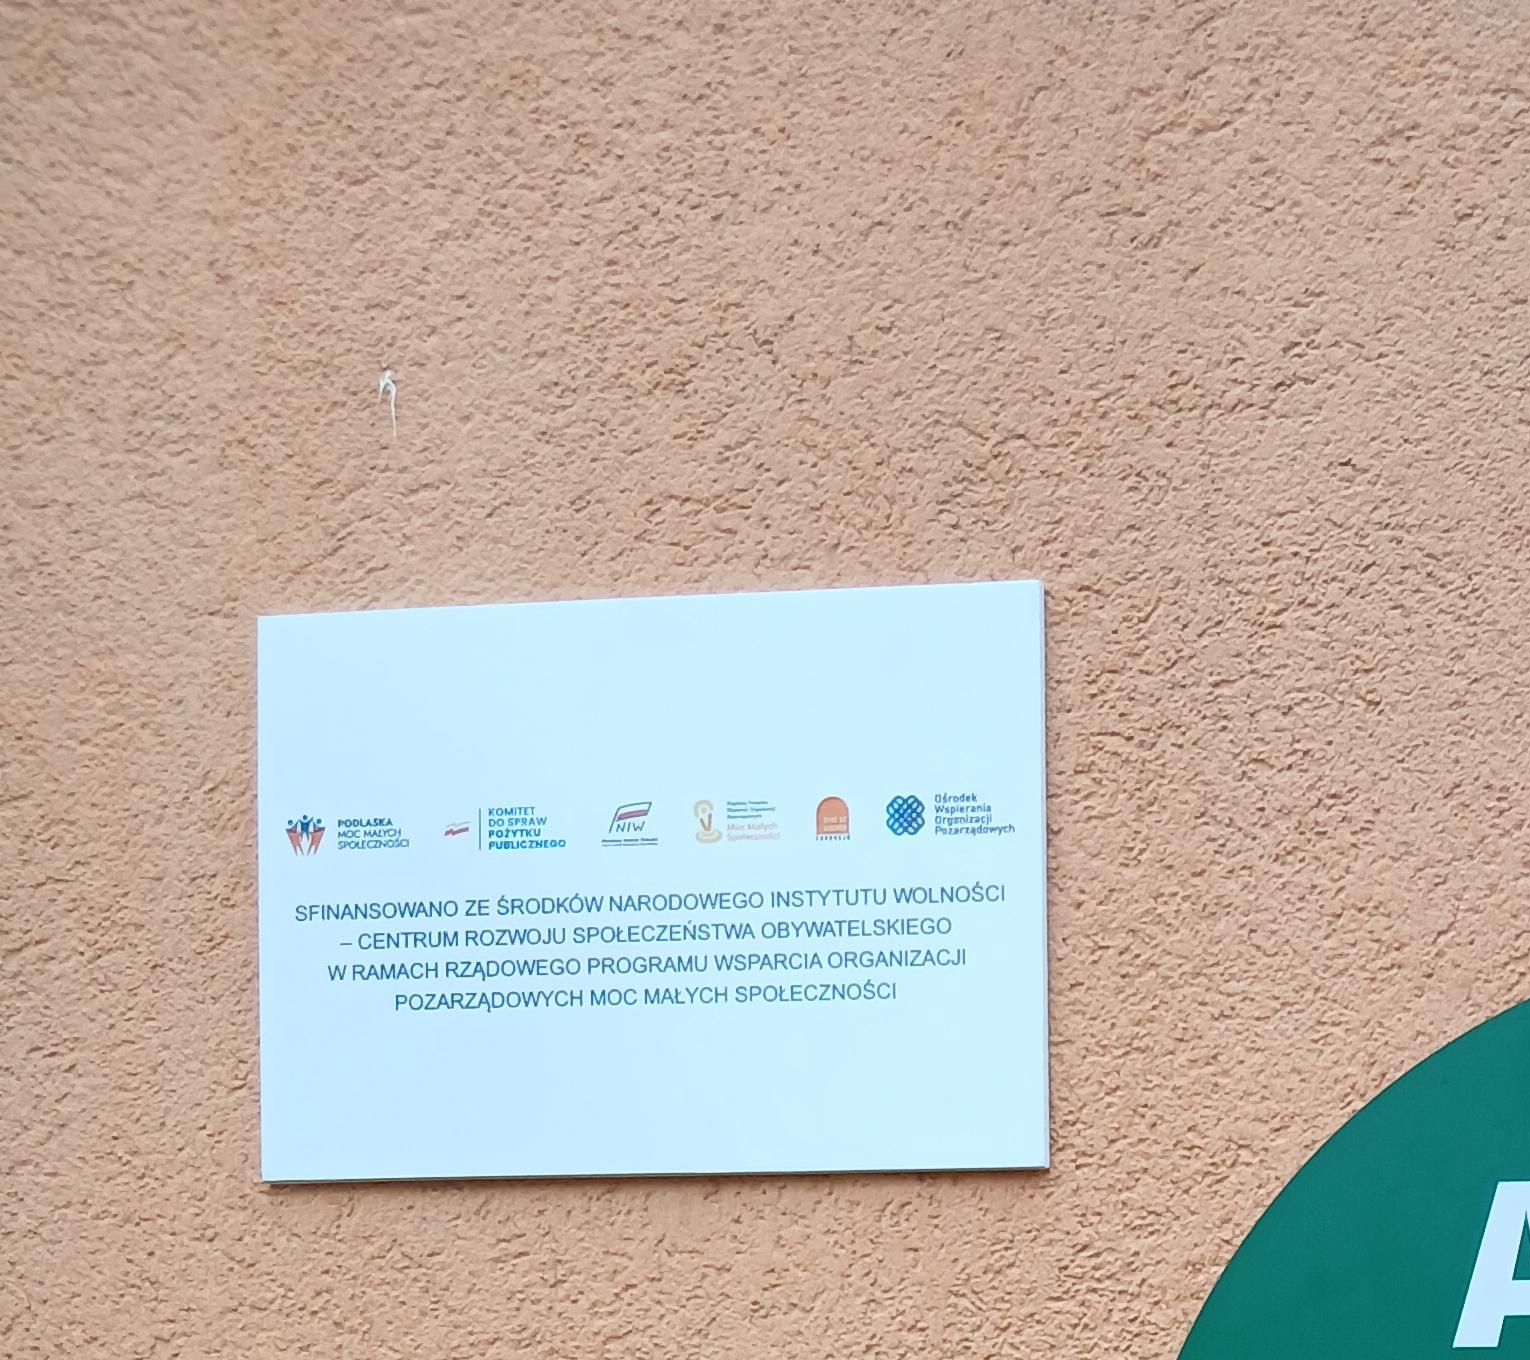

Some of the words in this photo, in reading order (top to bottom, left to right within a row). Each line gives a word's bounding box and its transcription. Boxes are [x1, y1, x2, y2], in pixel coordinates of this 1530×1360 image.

[935, 793, 977, 803] Ośrodek
[488, 807, 535, 816] KOMITET
[935, 803, 992, 815] Wspierania
[337, 818, 393, 828] PODLASKA
[488, 818, 505, 827] DO
[507, 817, 547, 826] SPRAW
[616, 820, 645, 832] NIW
[935, 814, 992, 826] Organizacji
[337, 830, 361, 839] MOC
[935, 824, 1015, 836] Pozarządowych
[488, 839, 567, 850] PUBLICZNEGO
[295, 901, 458, 921] SFINANSOWANO
[465, 899, 490, 917] ZE
[496, 893, 603, 916] ŚRODKÓW
[608, 891, 764, 913] NARODOWEGO
[771, 887, 887, 909] INSTYTUTU
[893, 881, 1006, 904] WOLNOŚCI
[358, 930, 459, 951] CENTRUM
[465, 928, 566, 948] ROZWOJU
[572, 919, 755, 945] SPOŁECZEŃSTWA
[761, 917, 952, 940] OBYWATELSKIEGO
[328, 965, 347, 981] W
[352, 962, 438, 981] RAMACH
[445, 958, 581, 982] RZĄDOWEGO
[588, 955, 708, 975] PROGRAMU
[714, 952, 822, 972] WSPARCIA
[828, 948, 966, 969] ORGANIZACJI
[395, 988, 583, 1013] POZARZĄDOWYCH
[590, 988, 638, 1007] MOC
[644, 986, 728, 1005] MAŁYCH
[735, 979, 896, 1004] SPOŁECZNOŚCI
